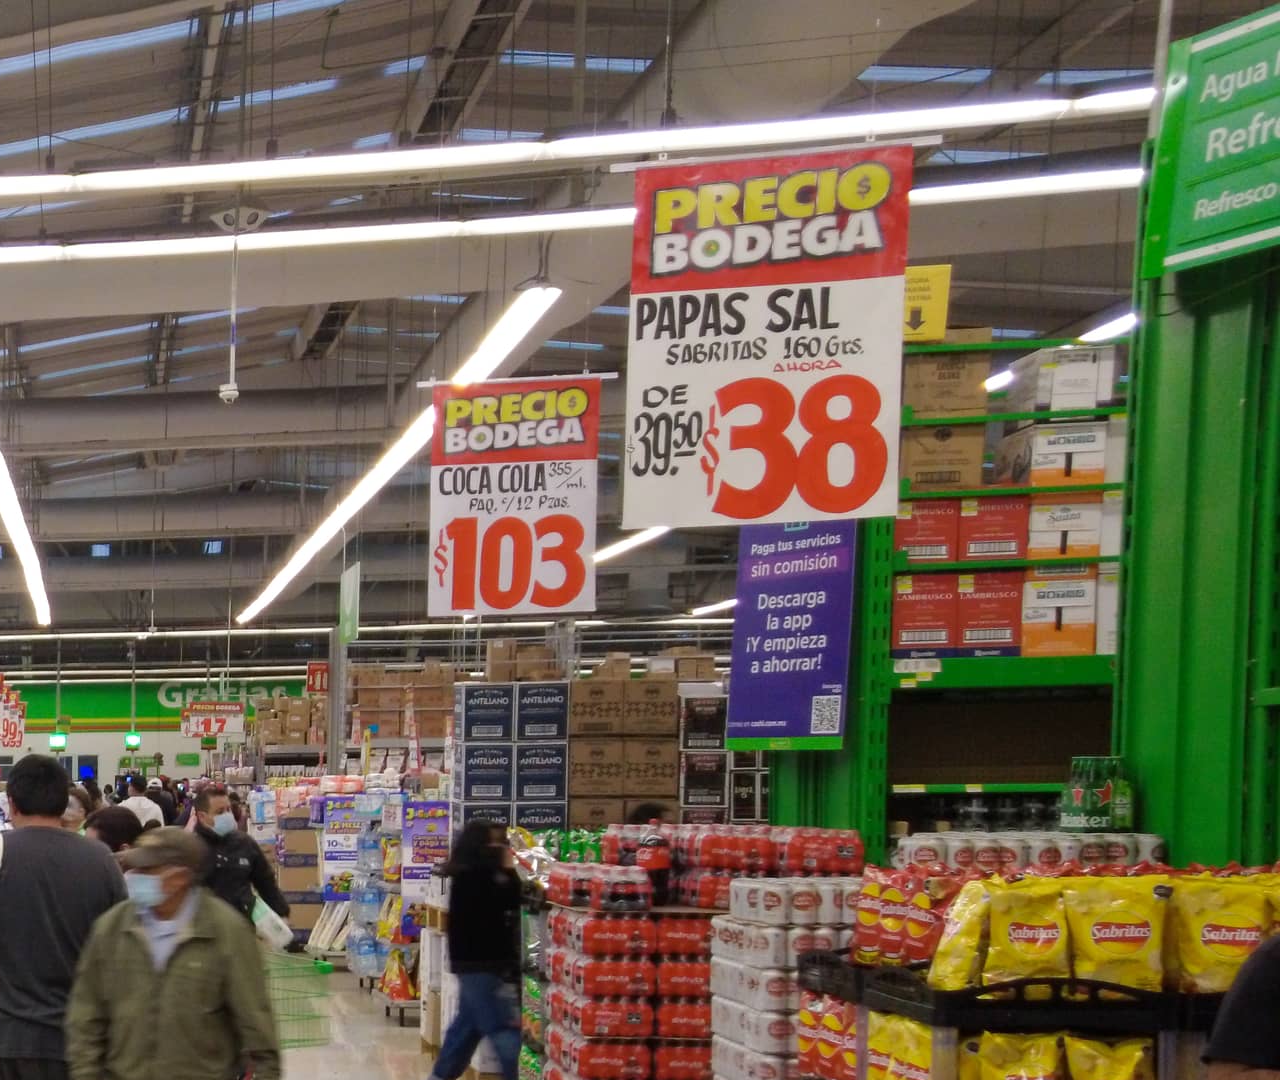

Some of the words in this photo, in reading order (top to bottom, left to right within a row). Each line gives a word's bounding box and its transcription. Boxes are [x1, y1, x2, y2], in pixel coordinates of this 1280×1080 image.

[1200, 61, 1267, 104] Agua
[654, 163, 890, 235] PRECIO
[1194, 182, 1278, 221] Refresco
[652, 209, 883, 276] BODEGA
[636, 292, 748, 340] PAPAS
[766, 287, 839, 333] SAL
[666, 337, 767, 366] SABRITAS
[784, 336, 820, 360] 160
[773, 360, 842, 372] AHORA
[445, 387, 588, 428] PRECIO
[643, 385, 688, 408] DE
[444, 418, 584, 454] BODEGA
[439, 466, 492, 495] COCA
[498, 463, 547, 493] COLA
[751, 544, 775, 555] Paga
[778, 540, 793, 551] tus
[795, 533, 841, 549] servicios
[751, 561, 769, 577] sin
[774, 553, 837, 574] comisión
[758, 591, 826, 611] Descarga
[766, 614, 779, 630] la
[783, 613, 812, 631] app
[764, 633, 827, 652] empieza
[750, 661, 759, 673] a
[762, 653, 822, 672] ahorrar!
[1090, 924, 1151, 942] Sabritas
